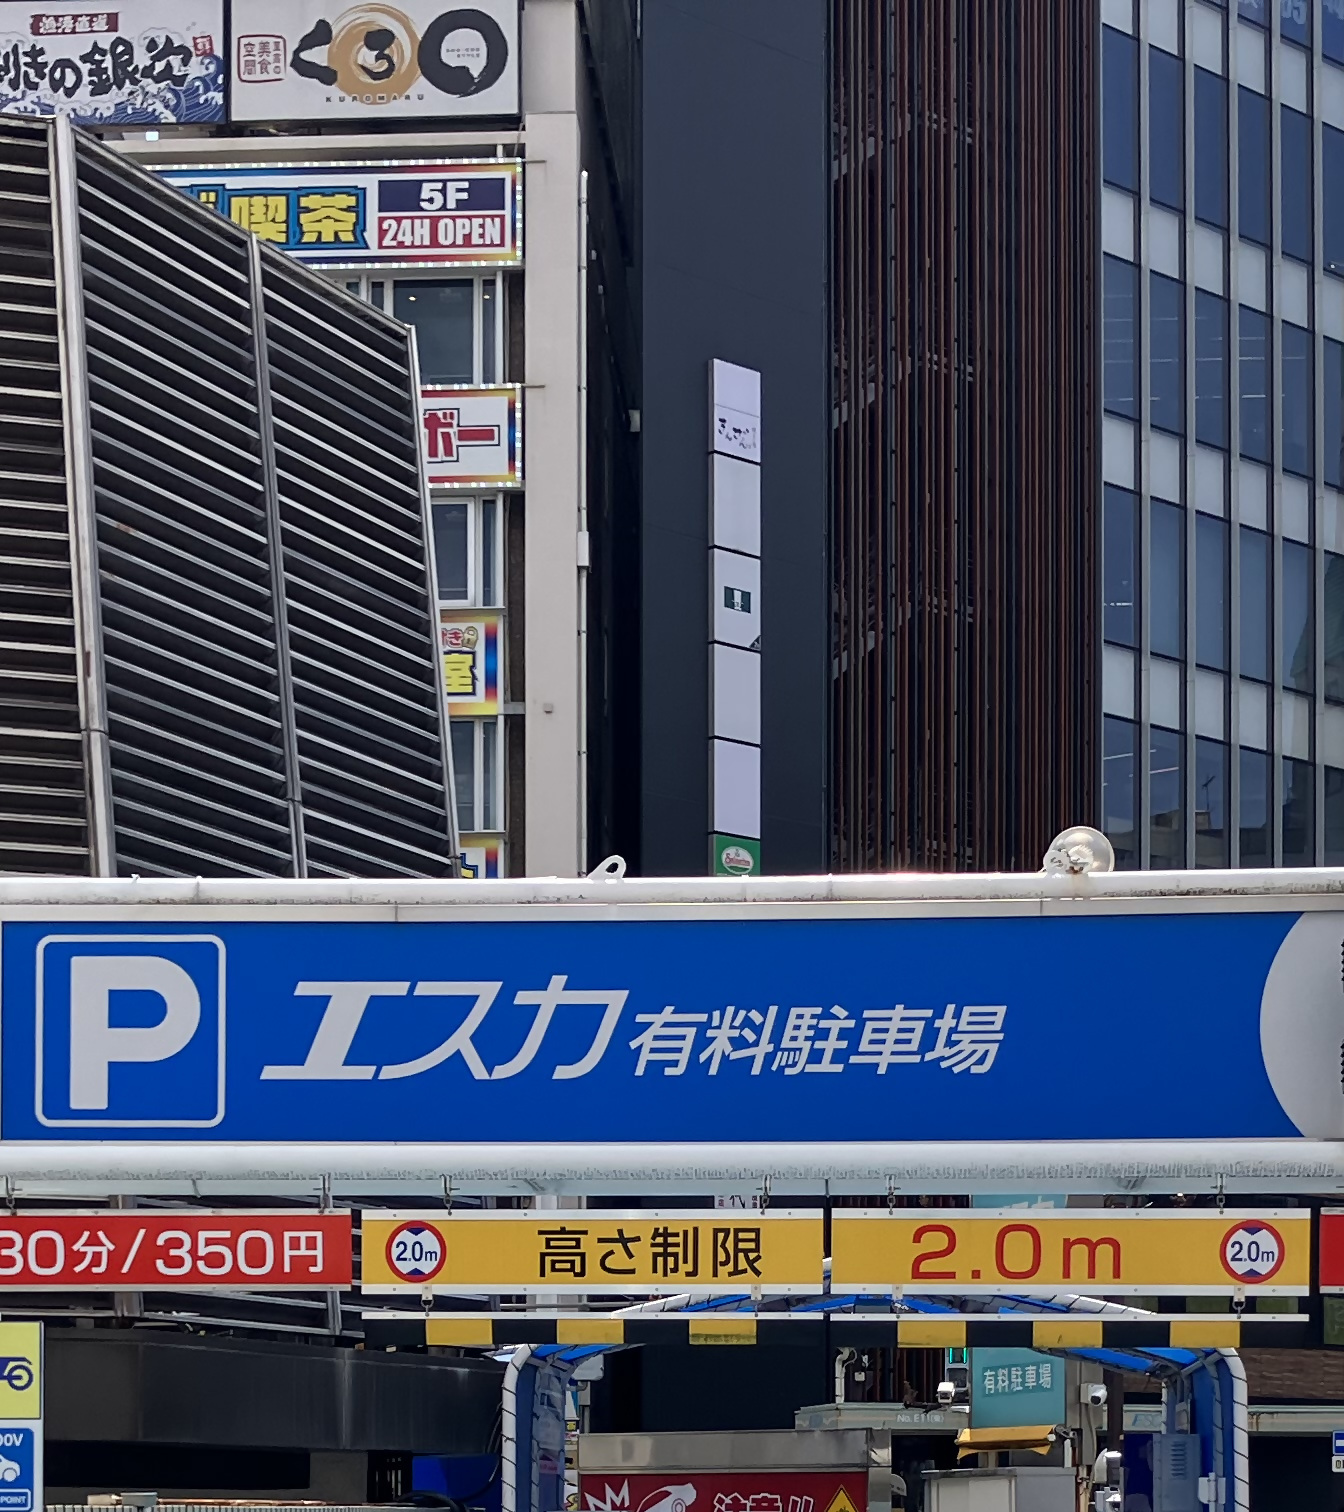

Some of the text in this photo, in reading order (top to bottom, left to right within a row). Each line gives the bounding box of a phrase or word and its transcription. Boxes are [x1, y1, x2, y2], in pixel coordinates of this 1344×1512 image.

[325, 93, 425, 103] KUROMARU
[419, 182, 470, 210] 5F
[382, 217, 502, 247] 24H OPEN
[69, 955, 202, 1111] P
[394, 1240, 440, 1266] 2.0m
[537, 1225, 765, 1280] 高さ制限
[911, 1223, 1122, 1280] 2.0m
[1230, 1240, 1275, 1265] 2.0m
[984, 1363, 1052, 1395] 有料駐車場
[0, 1495, 27, 1505] POINT
